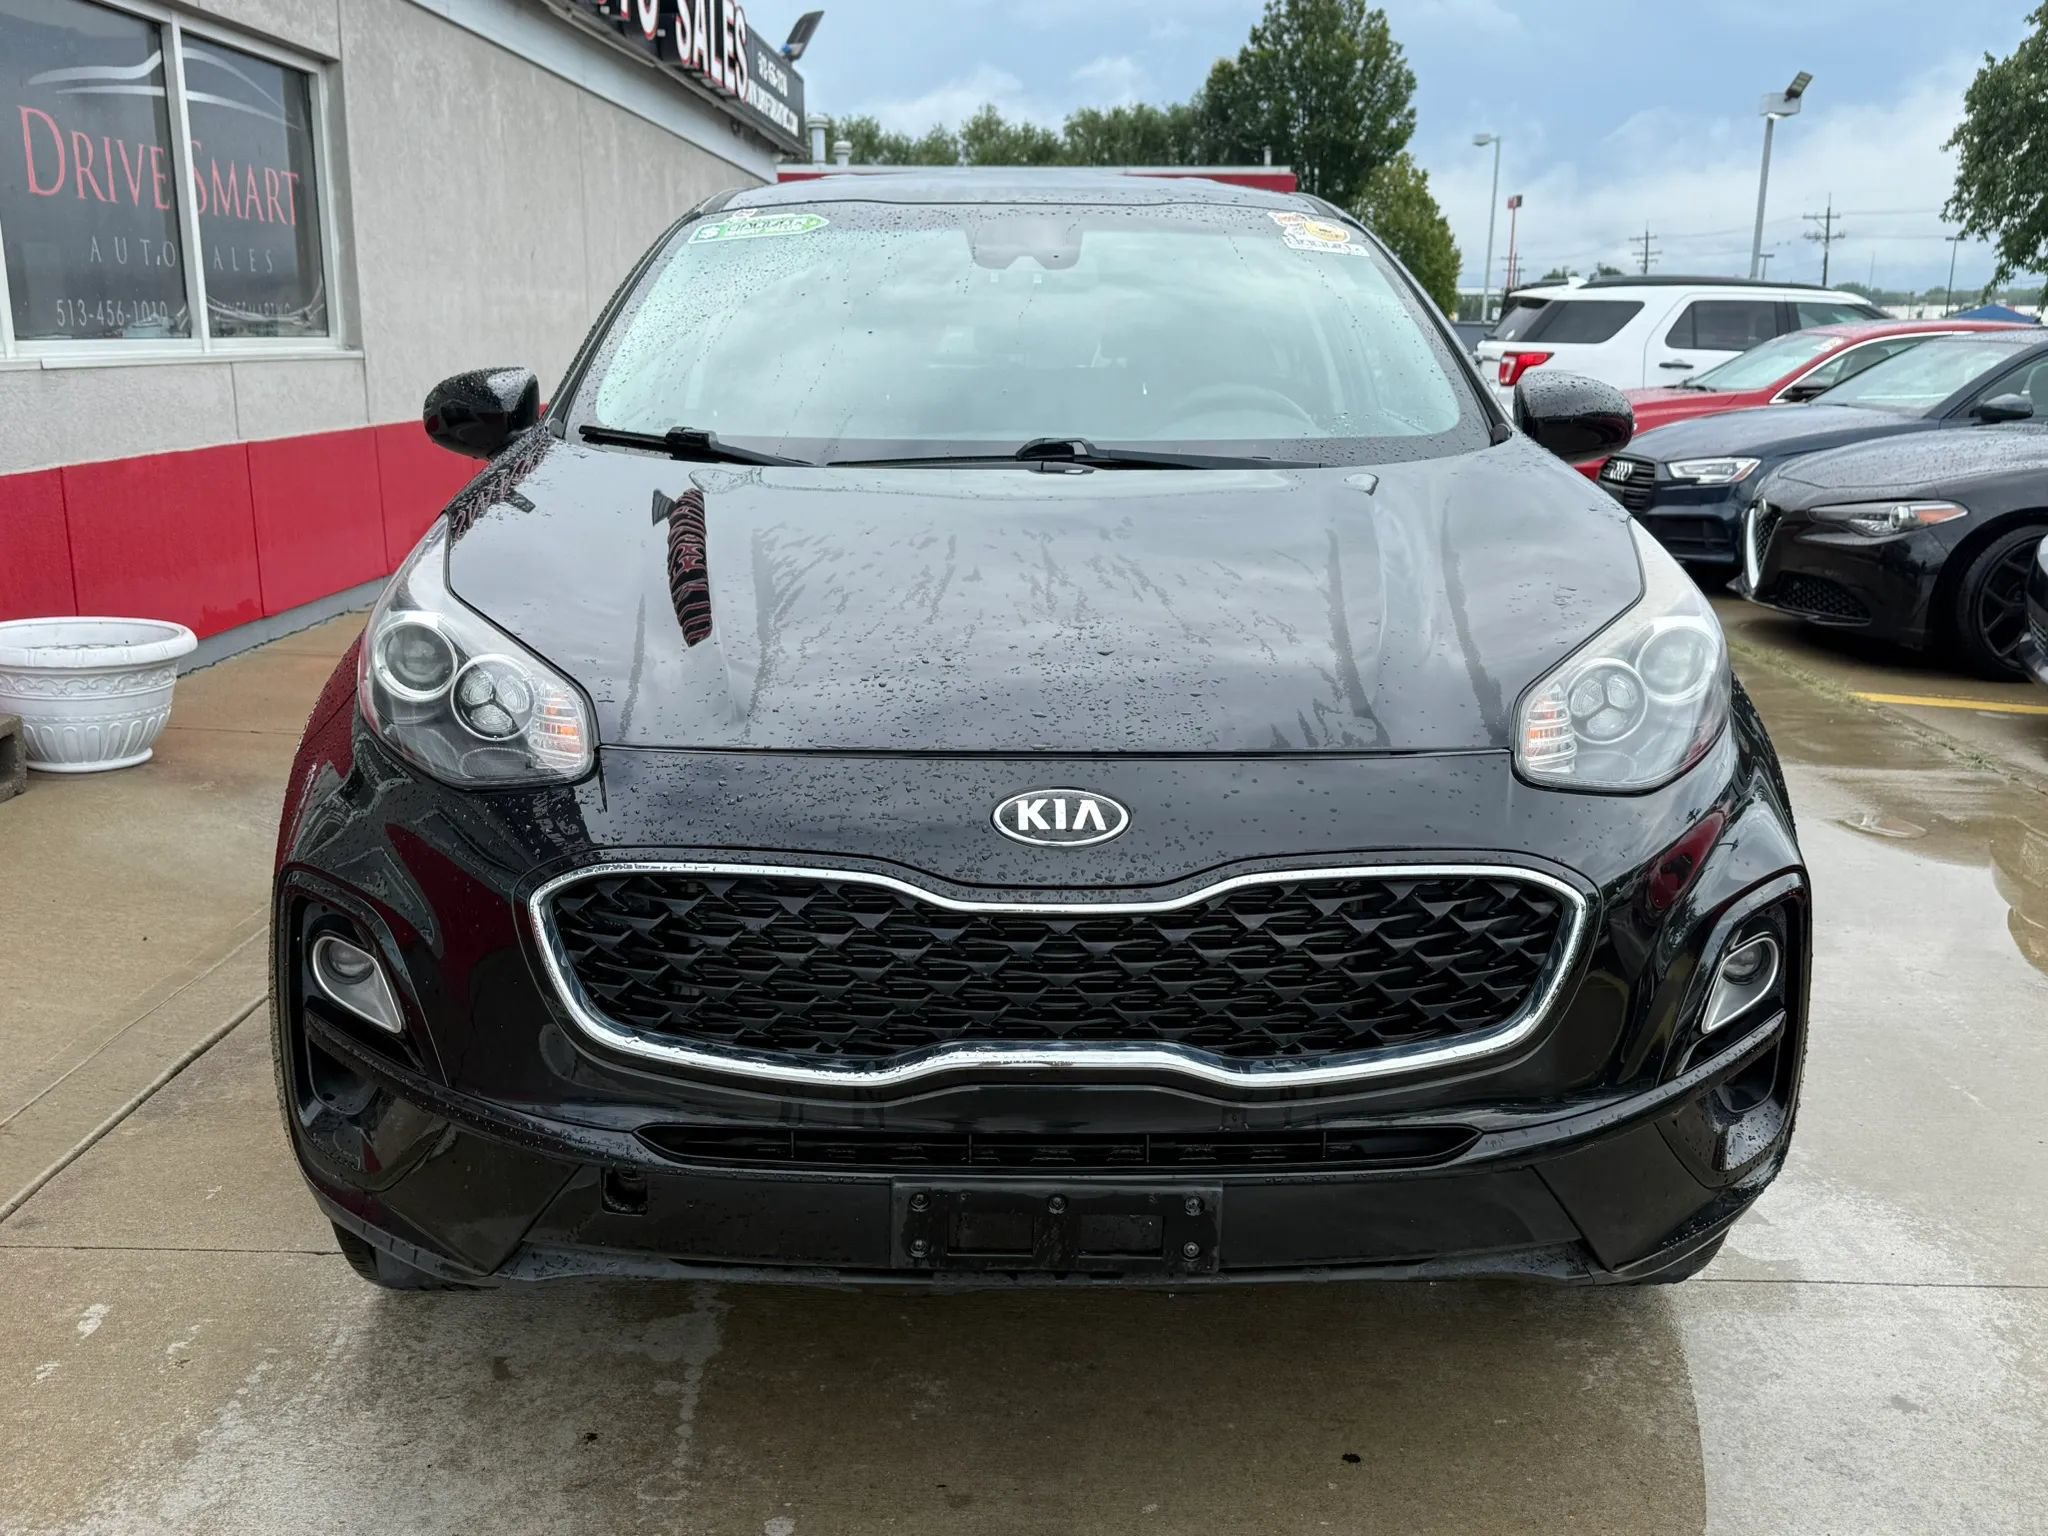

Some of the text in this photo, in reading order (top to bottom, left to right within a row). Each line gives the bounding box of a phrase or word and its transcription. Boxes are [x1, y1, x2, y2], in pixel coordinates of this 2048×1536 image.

[676, 0, 749, 103] SALES
[18, 105, 171, 211] DRIVE
[90, 235, 273, 274] AUTO ALES
[1016, 798, 1107, 831] KIA
